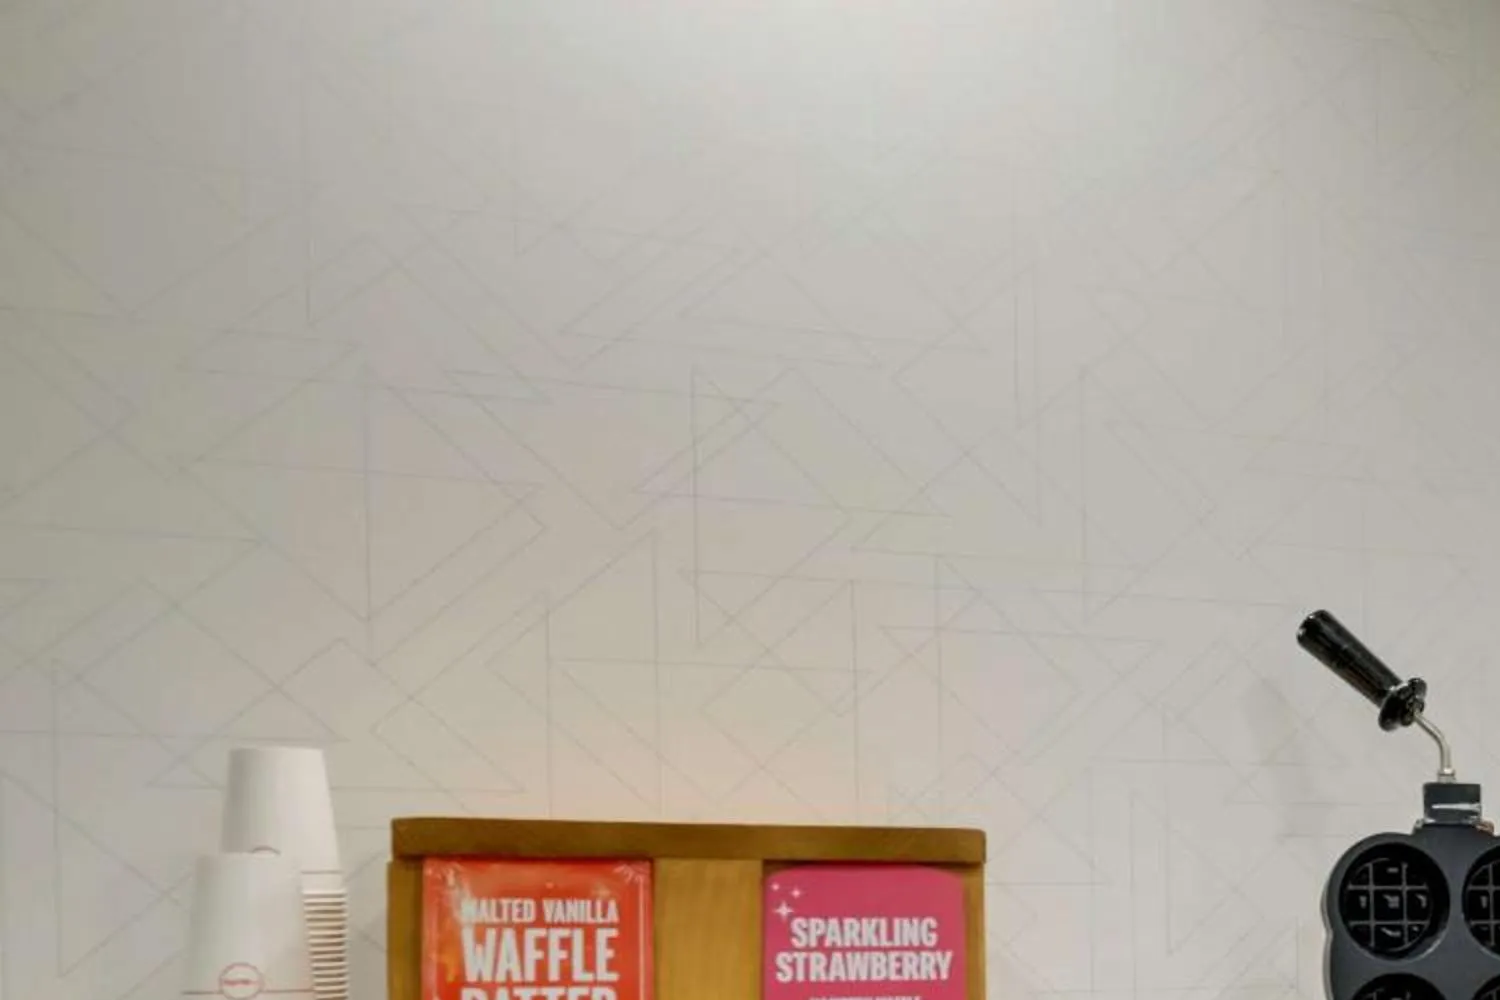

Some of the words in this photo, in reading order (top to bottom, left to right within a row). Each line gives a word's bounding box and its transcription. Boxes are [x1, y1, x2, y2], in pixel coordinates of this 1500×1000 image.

[543, 898, 620, 924] VANILLA
[790, 916, 939, 949] SPARKLING
[461, 927, 620, 983] WAFFLE
[775, 950, 953, 983] STRAWBERRY
